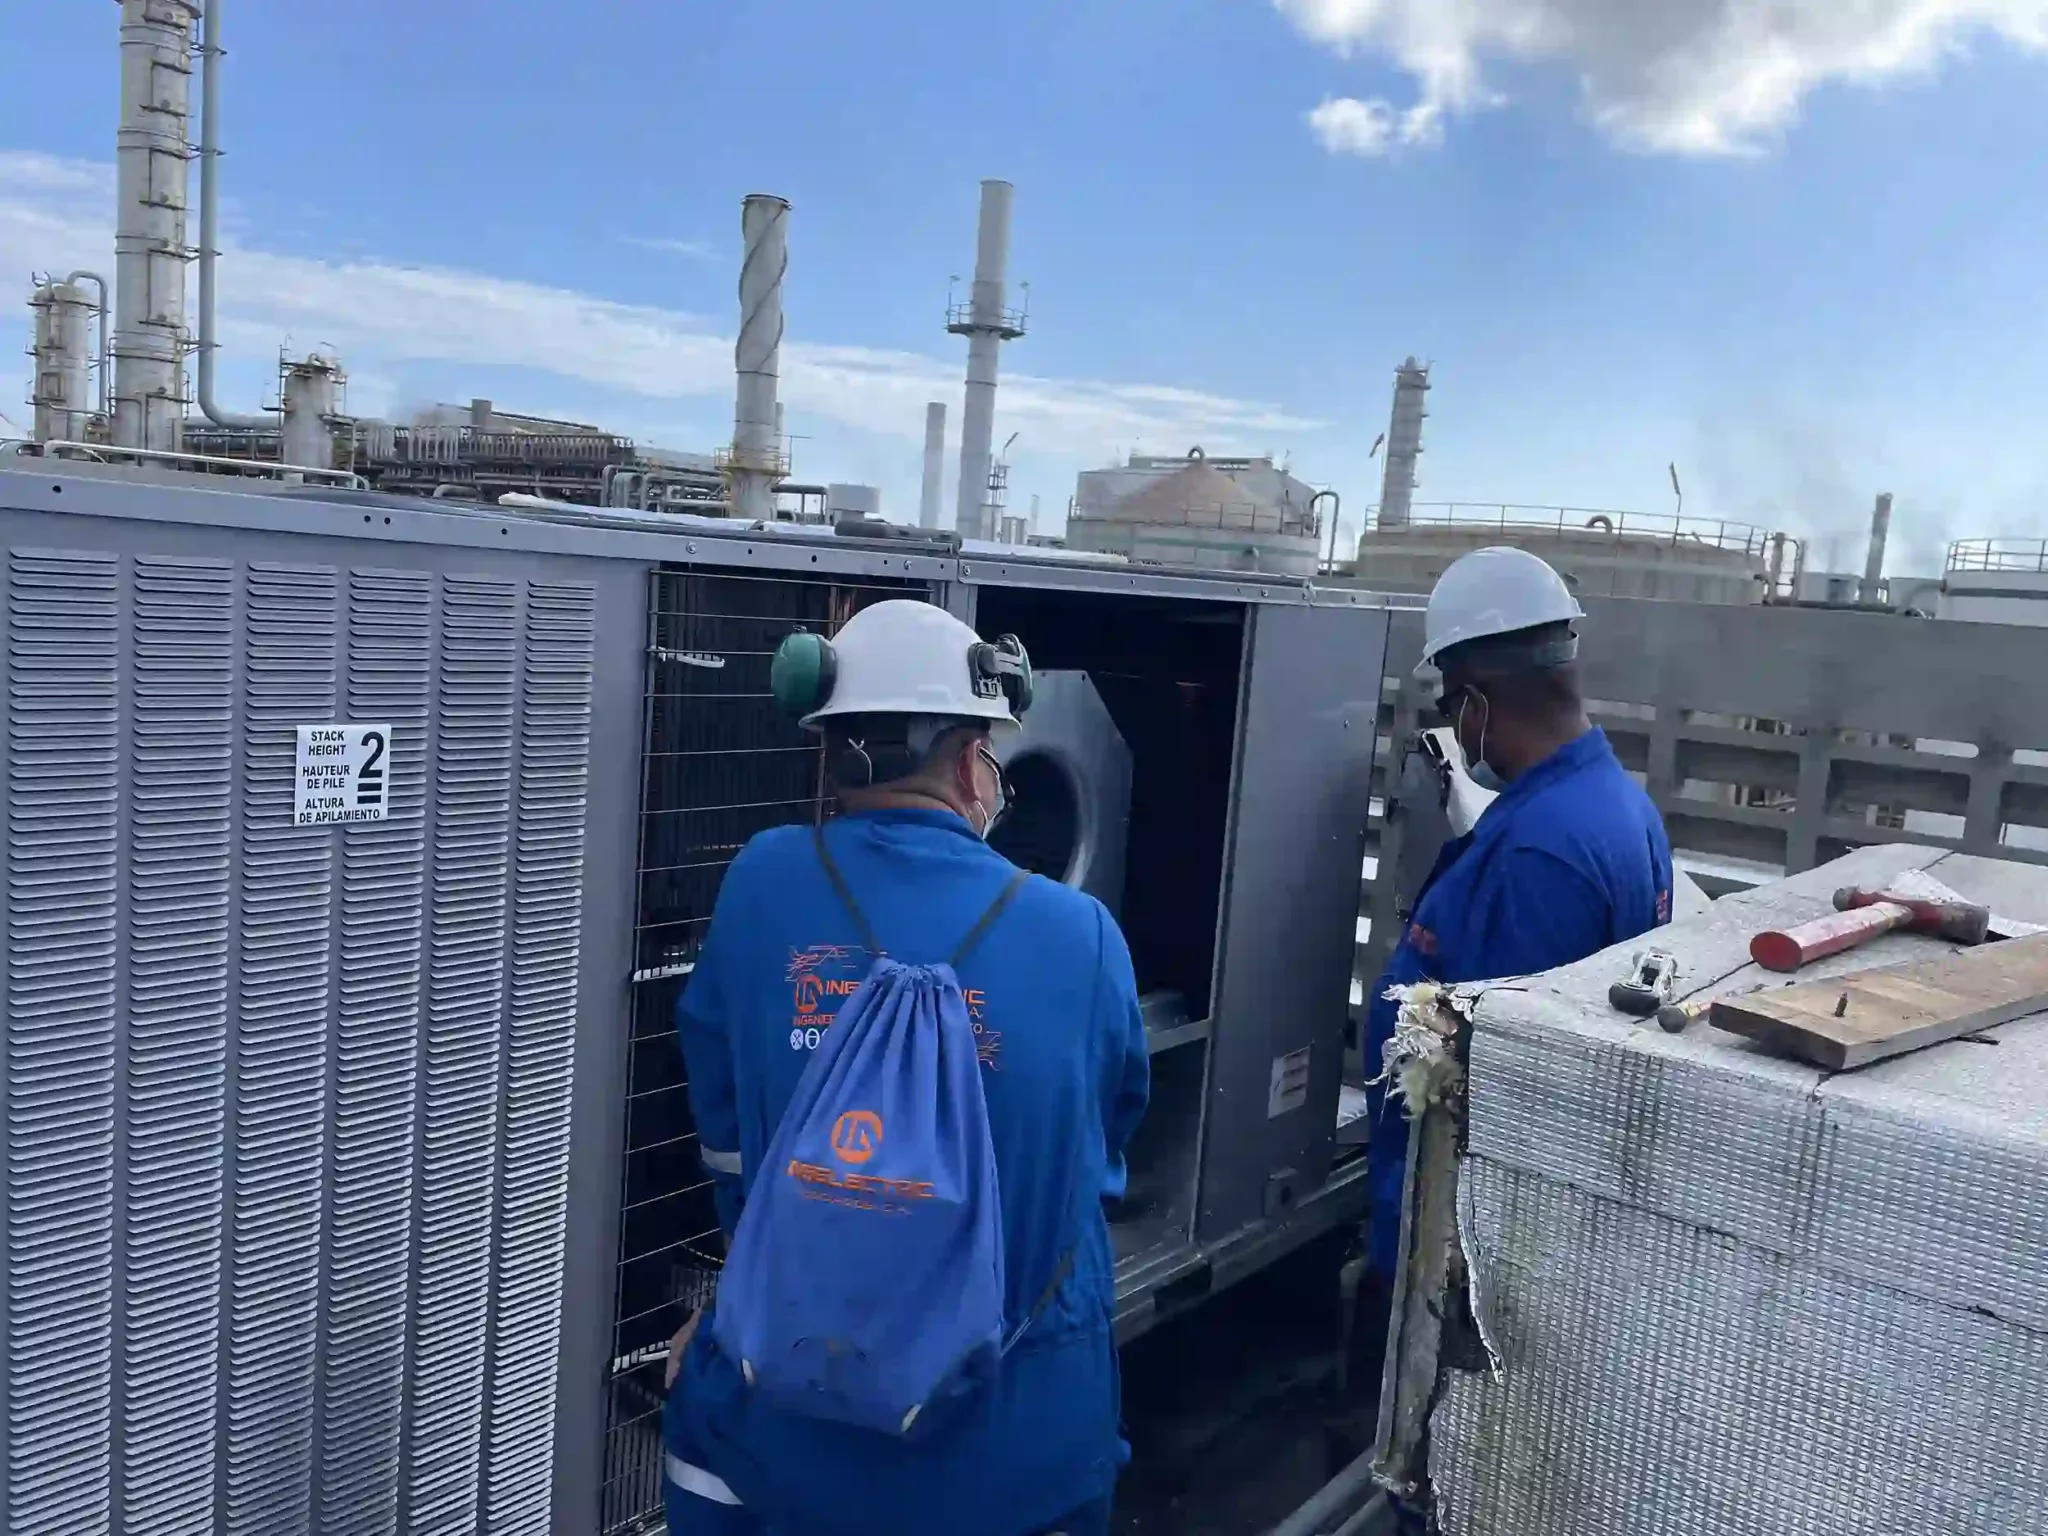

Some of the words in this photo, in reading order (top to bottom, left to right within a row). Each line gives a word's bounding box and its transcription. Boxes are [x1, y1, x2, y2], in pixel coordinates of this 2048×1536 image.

[311, 730, 345, 742] STACK
[308, 744, 346, 756] HEIGHT
[358, 731, 384, 779] 2
[302, 765, 350, 777] HAUTEUR
[307, 779, 320, 790] DE
[323, 777, 345, 789] PILE
[305, 797, 345, 809] ALTURA
[299, 812, 312, 823] DE
[315, 809, 380, 822] APILAMIENTO
